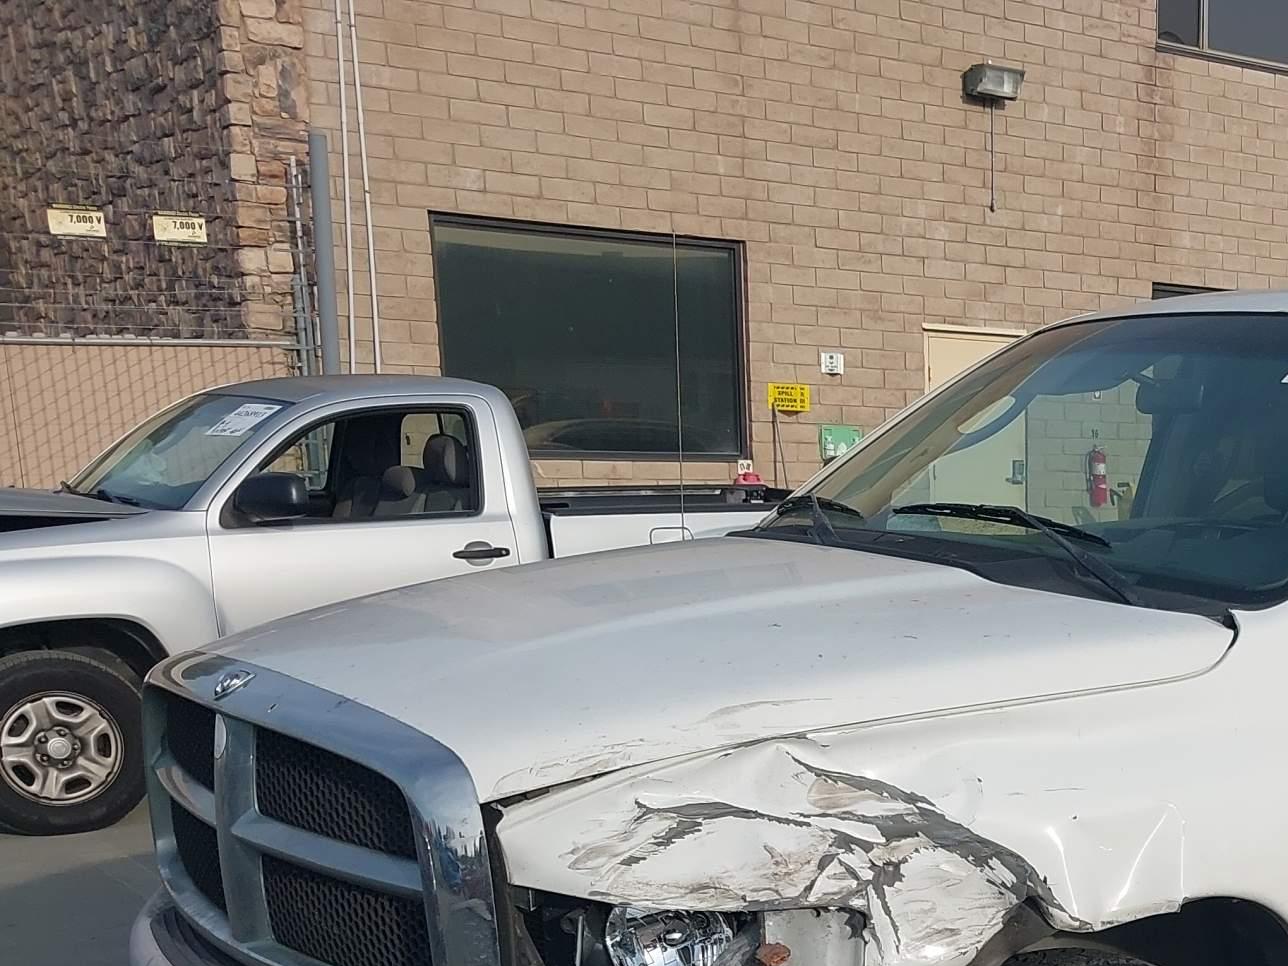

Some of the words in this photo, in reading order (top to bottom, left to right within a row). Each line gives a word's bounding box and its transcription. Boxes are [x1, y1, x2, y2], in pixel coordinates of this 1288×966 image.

[68, 214, 94, 225] 7,000
[95, 215, 102, 225] V
[172, 221, 196, 230] 7,000
[197, 222, 203, 231] V
